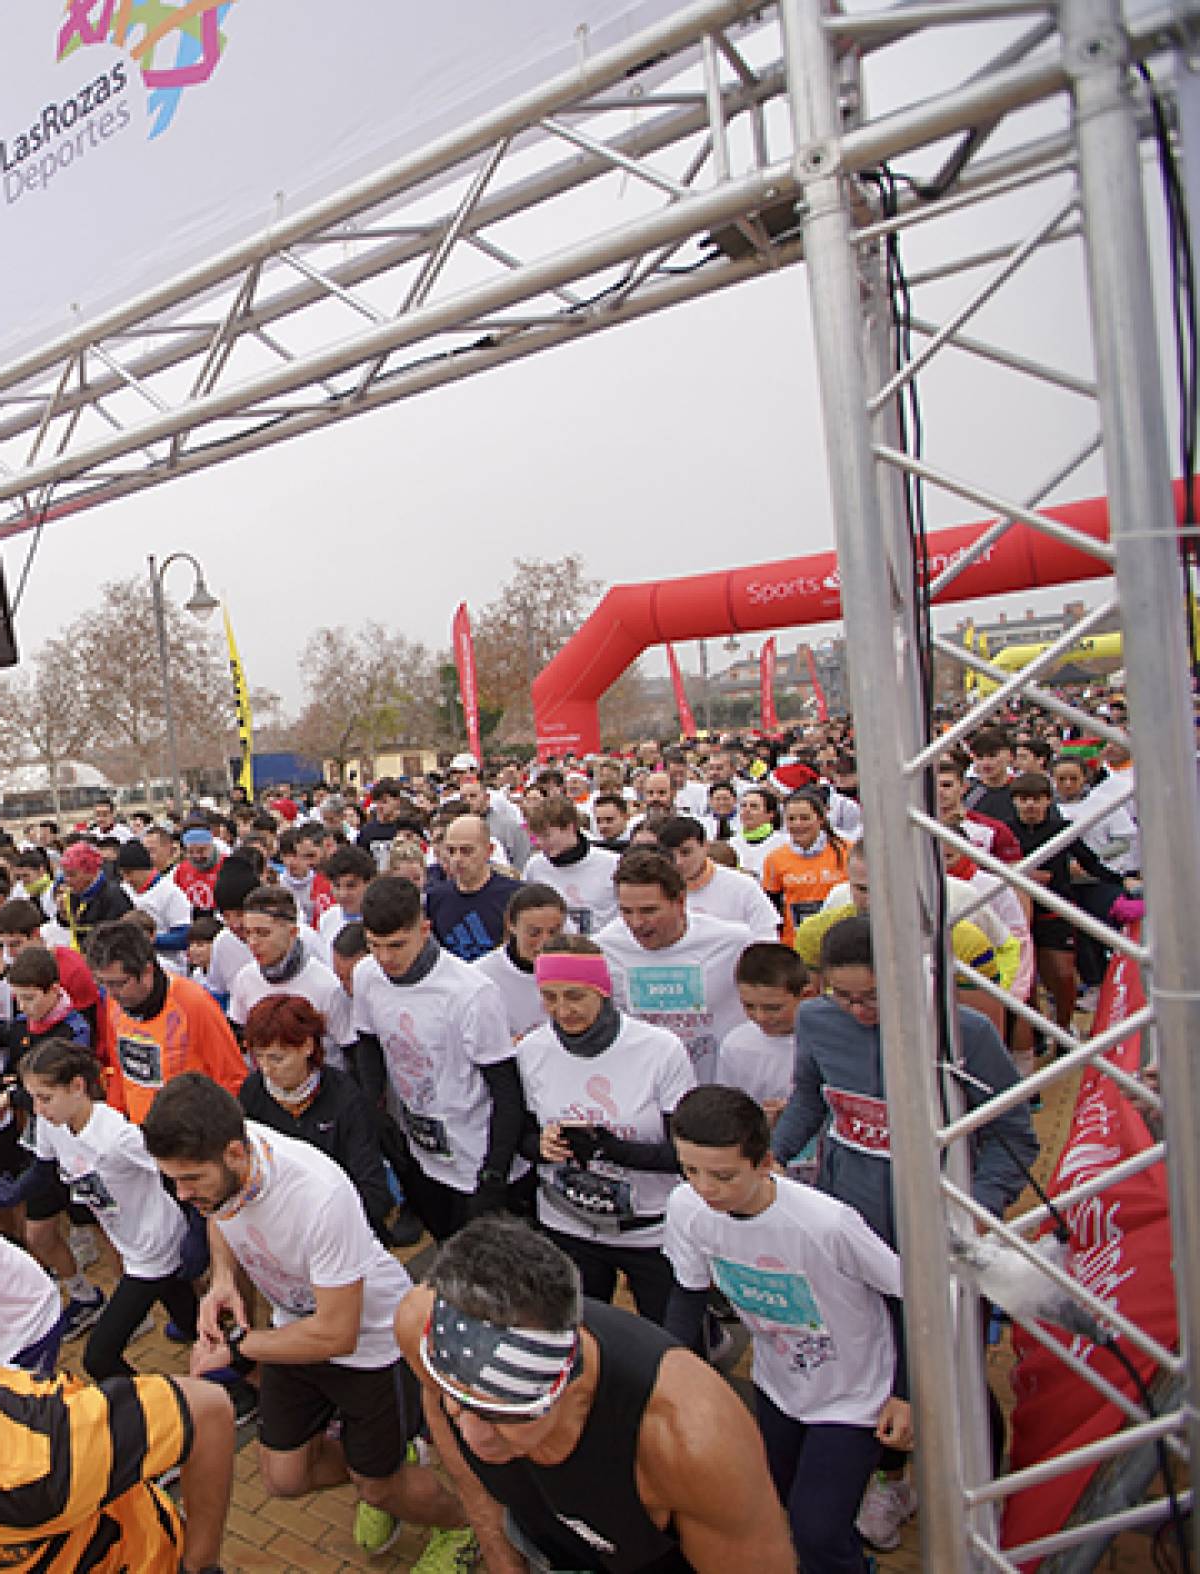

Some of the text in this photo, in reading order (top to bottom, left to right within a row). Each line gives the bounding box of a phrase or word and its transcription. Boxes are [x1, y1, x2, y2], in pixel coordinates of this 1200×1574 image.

[0, 60, 127, 172] LasRozas
[3, 100, 130, 204] Deportes
[745, 576, 820, 604] Sports
